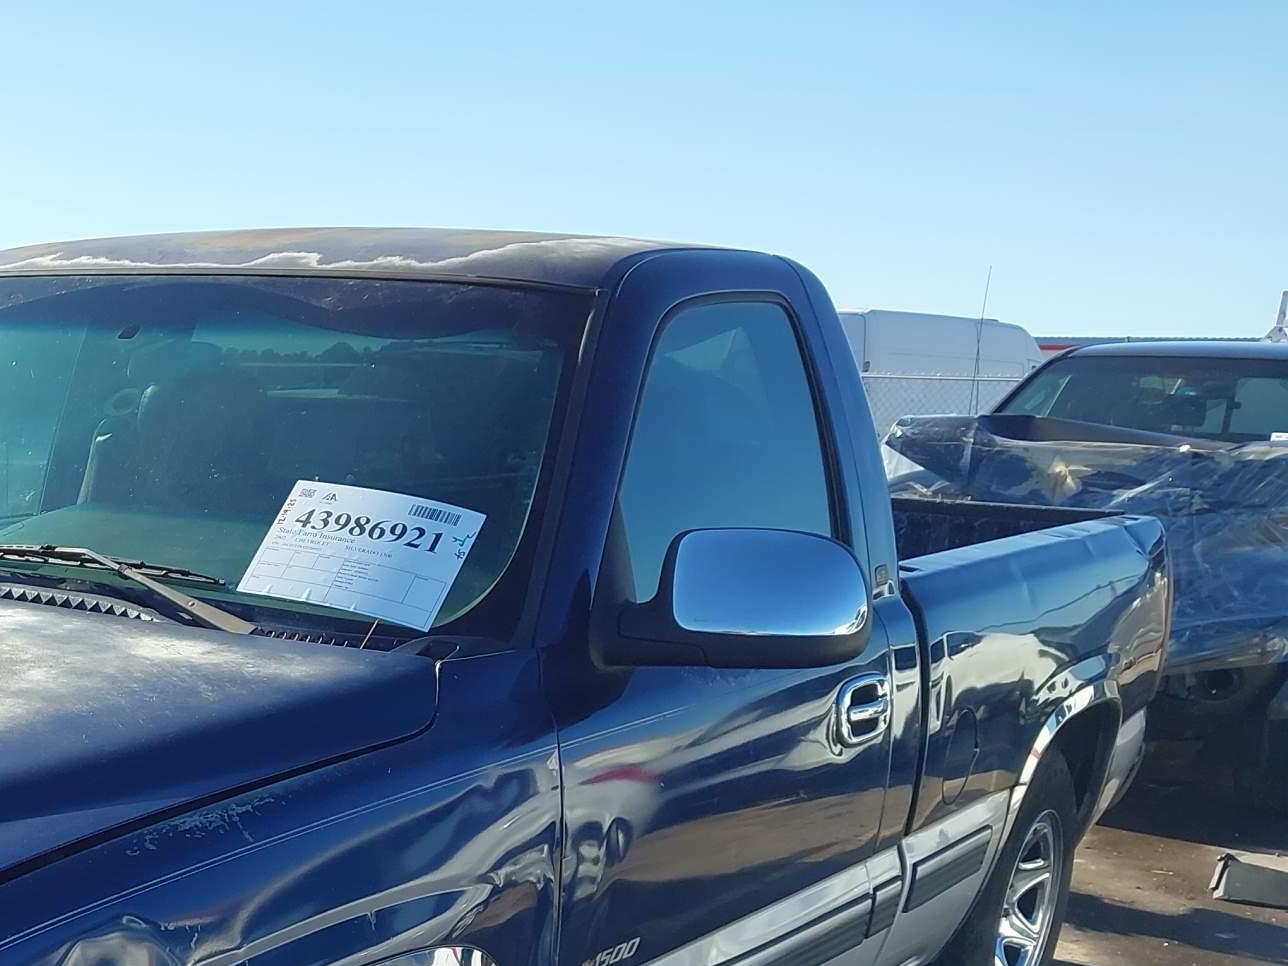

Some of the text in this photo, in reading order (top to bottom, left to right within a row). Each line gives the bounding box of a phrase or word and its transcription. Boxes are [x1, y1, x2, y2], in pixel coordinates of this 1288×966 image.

[278, 527, 296, 535] State
[298, 529, 317, 539] Farm
[319, 532, 356, 544] Insurance
[294, 508, 445, 555] 43986921
